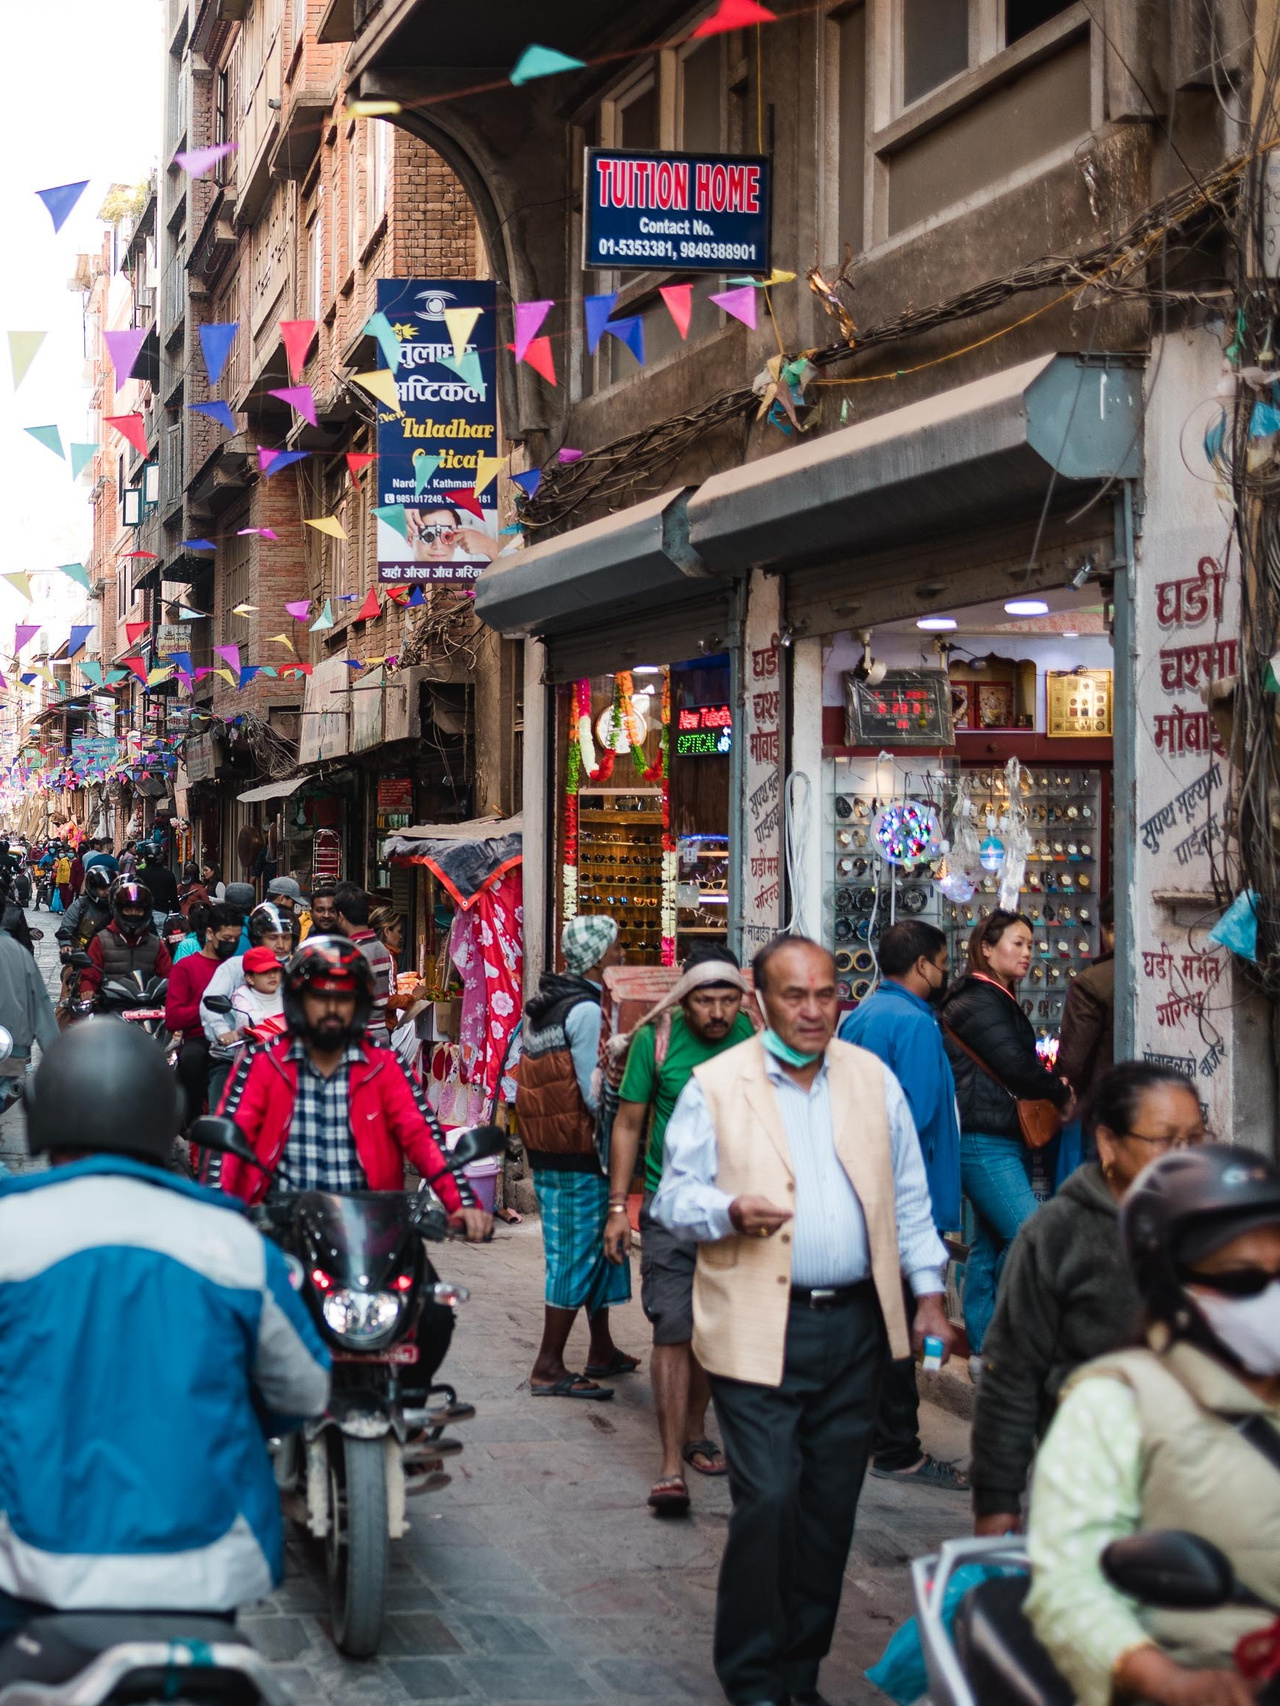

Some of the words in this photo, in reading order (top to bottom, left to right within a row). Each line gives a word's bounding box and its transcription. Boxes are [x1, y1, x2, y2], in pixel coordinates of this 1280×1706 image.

[597, 159, 689, 210] TUITION
[696, 163, 760, 213] HOME
[639, 216, 690, 235] Contact
[693, 220, 714, 236] No.
[598, 238, 677, 260] 01-5353381,
[680, 241, 756, 260] 9849388901
[378, 410, 406, 424] New
[401, 417, 494, 438] Tuladhar
[677, 733, 717, 753] OPTICAL
